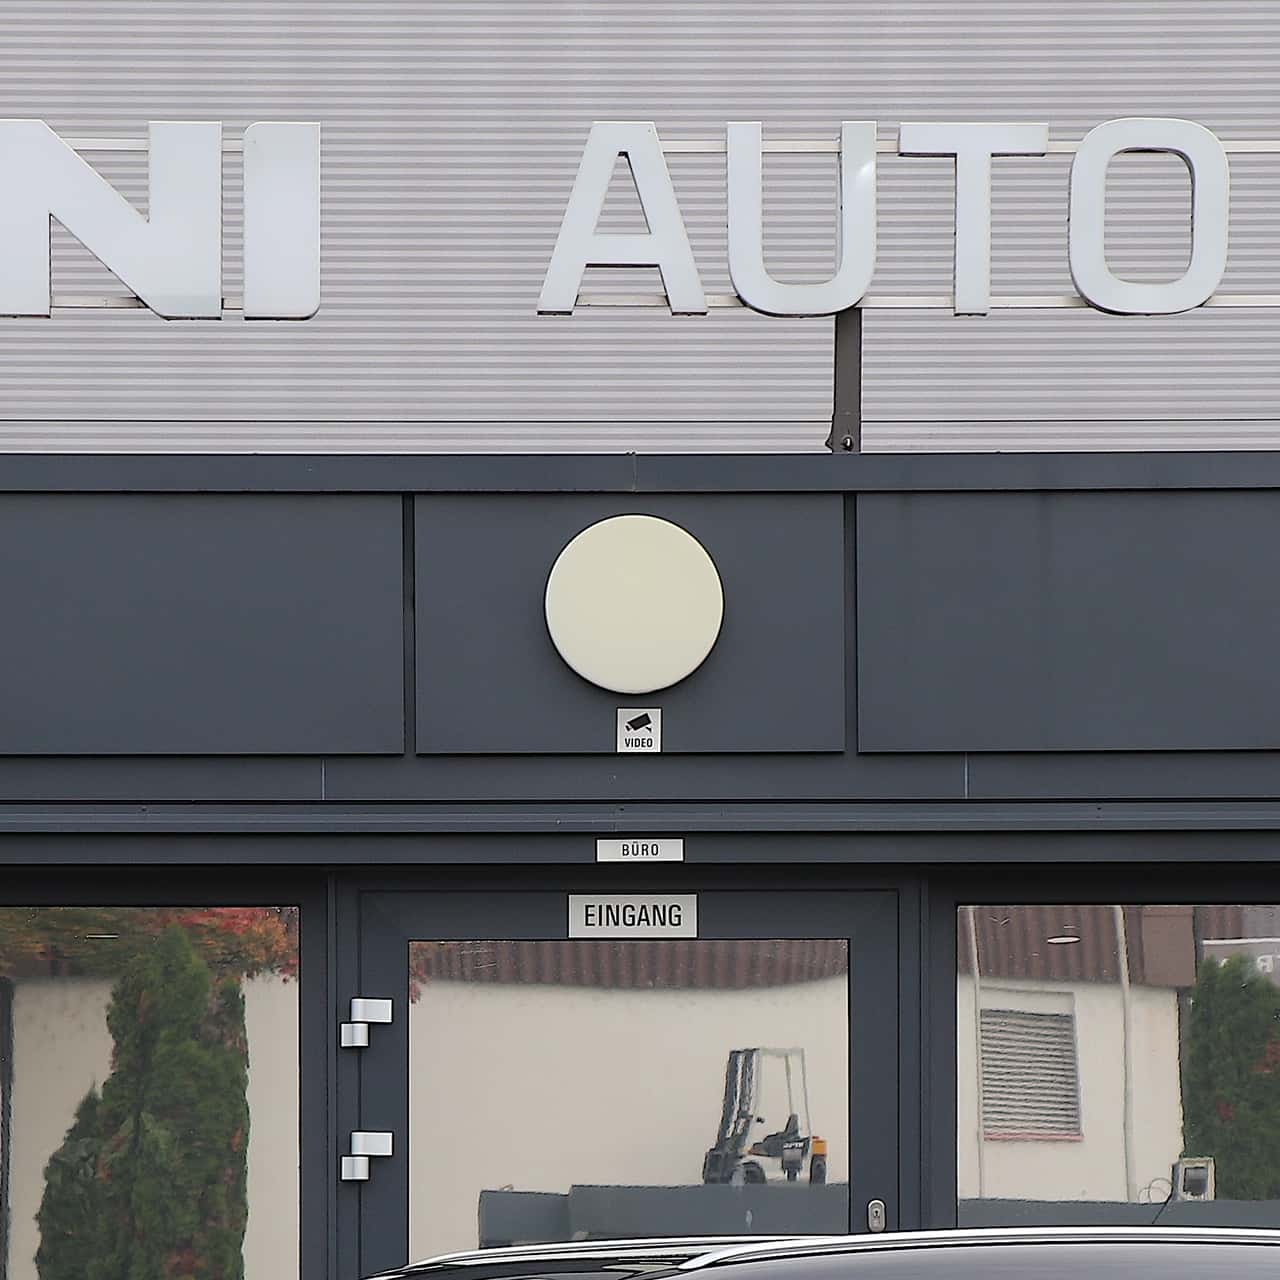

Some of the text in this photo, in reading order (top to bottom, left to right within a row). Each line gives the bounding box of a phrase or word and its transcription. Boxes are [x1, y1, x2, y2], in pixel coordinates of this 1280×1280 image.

[536, 115, 1230, 318] AUTO
[624, 737, 654, 749] VIDEO
[621, 840, 660, 857] BÜRO
[584, 903, 683, 927] EINGANG
